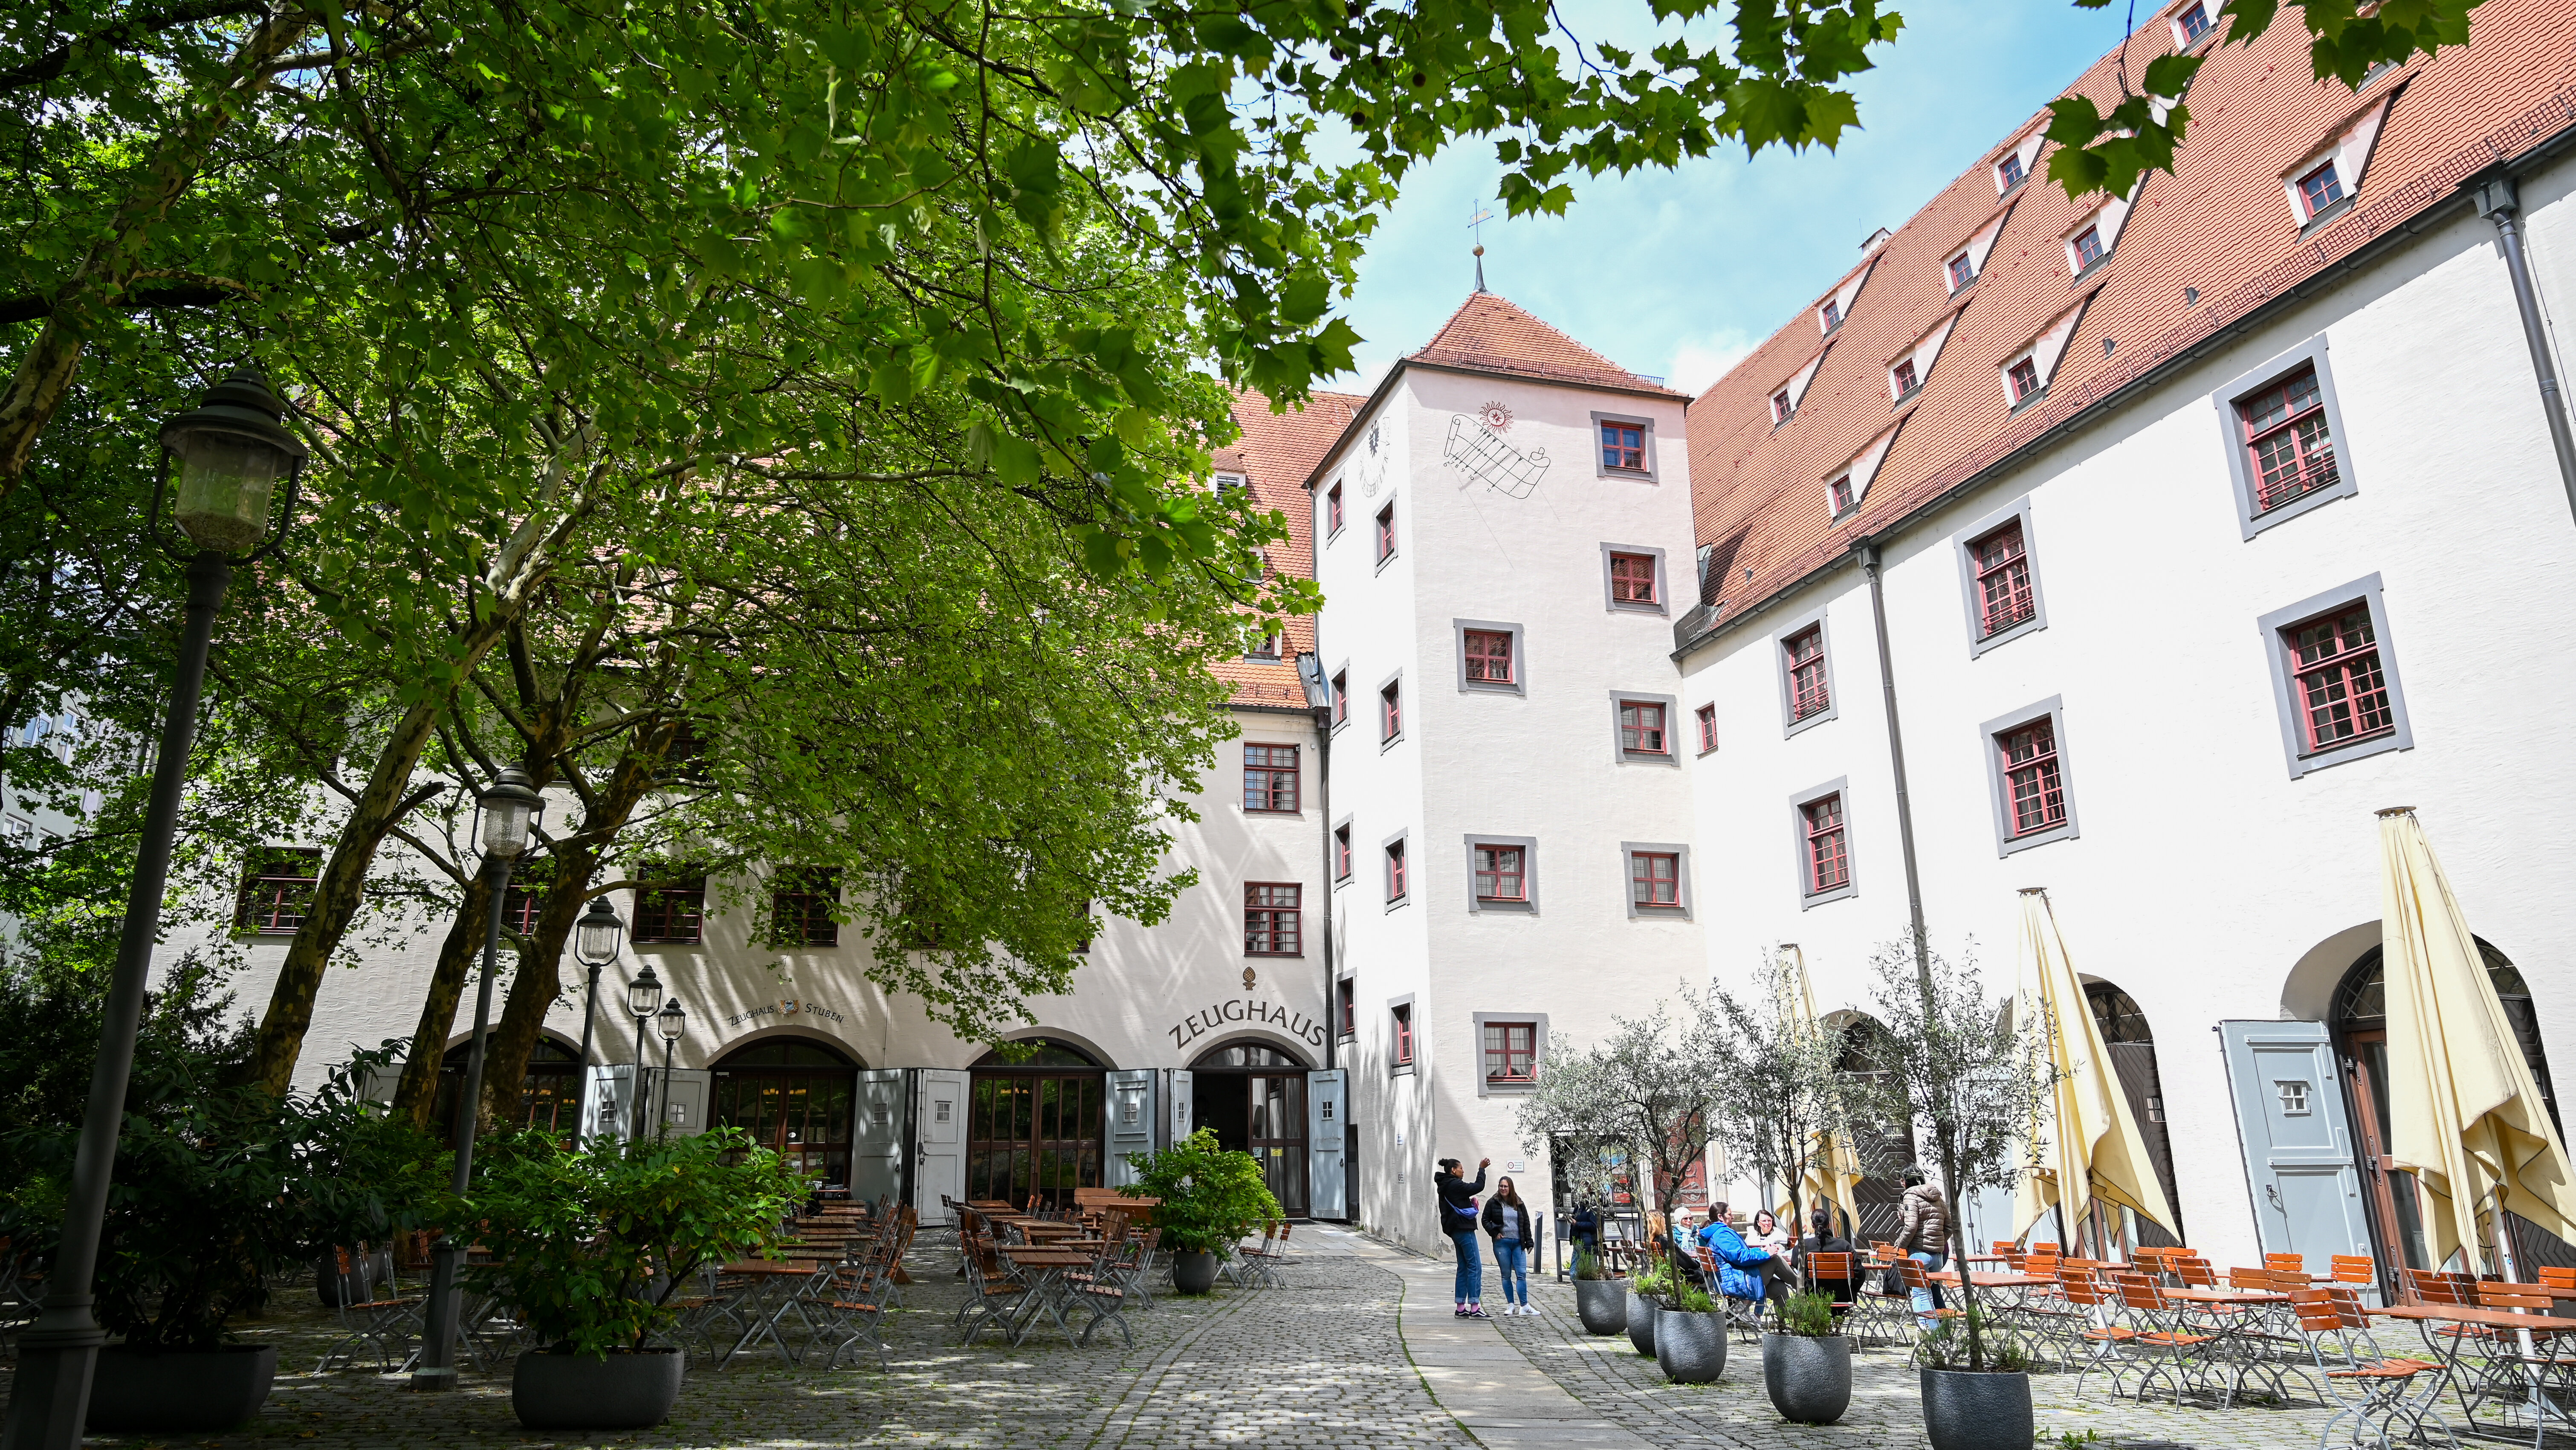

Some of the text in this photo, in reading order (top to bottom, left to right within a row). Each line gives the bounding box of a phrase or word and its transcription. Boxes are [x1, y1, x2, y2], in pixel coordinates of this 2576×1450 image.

[728, 1003, 844, 1027] ZEUGHAUS STUBEN
[1168, 999, 1326, 1050] ZEUGHAUS
